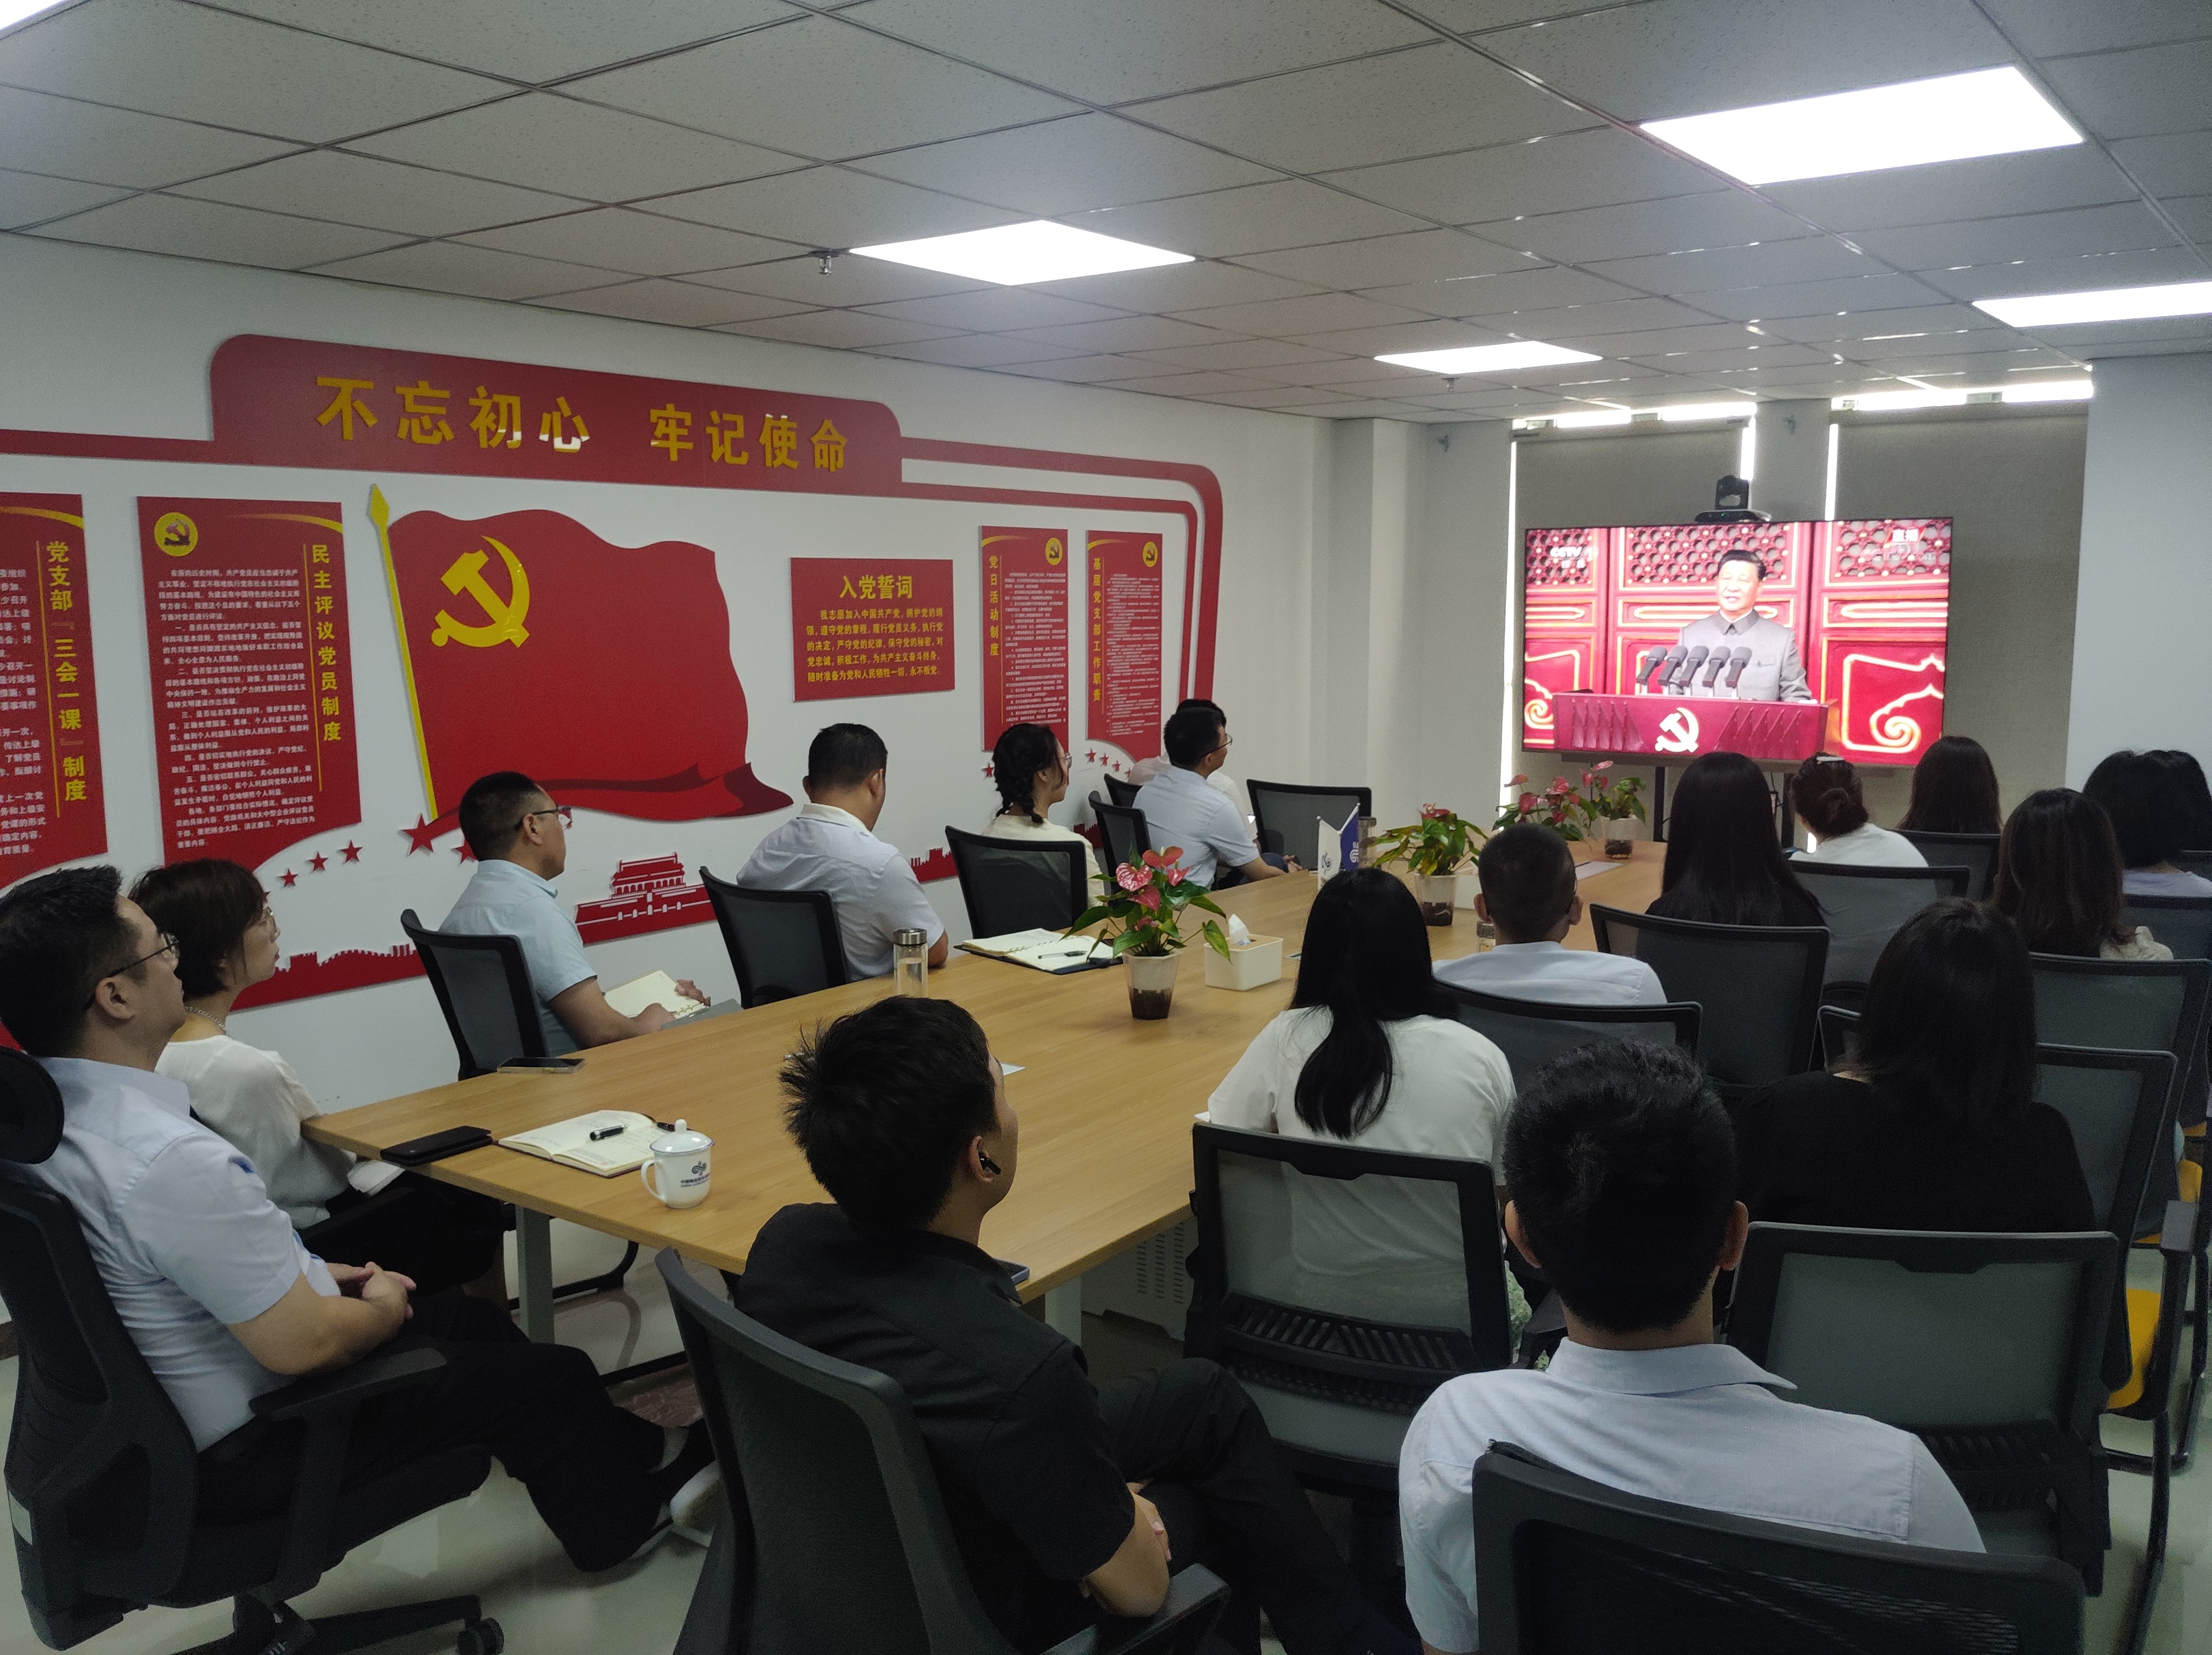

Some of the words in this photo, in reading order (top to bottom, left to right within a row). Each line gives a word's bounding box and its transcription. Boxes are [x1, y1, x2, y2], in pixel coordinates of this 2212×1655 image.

[315, 376, 590, 454] 不忘初心
[649, 403, 847, 473] 牢记使命
[839, 575, 913, 600] 入党誓词
[1550, 547, 1582, 558] CCTV
[311, 544, 341, 742] 民主评议党员制度
[989, 555, 1000, 657] 党日活动制度
[1093, 558, 1102, 701] 基层党支部工作职责
